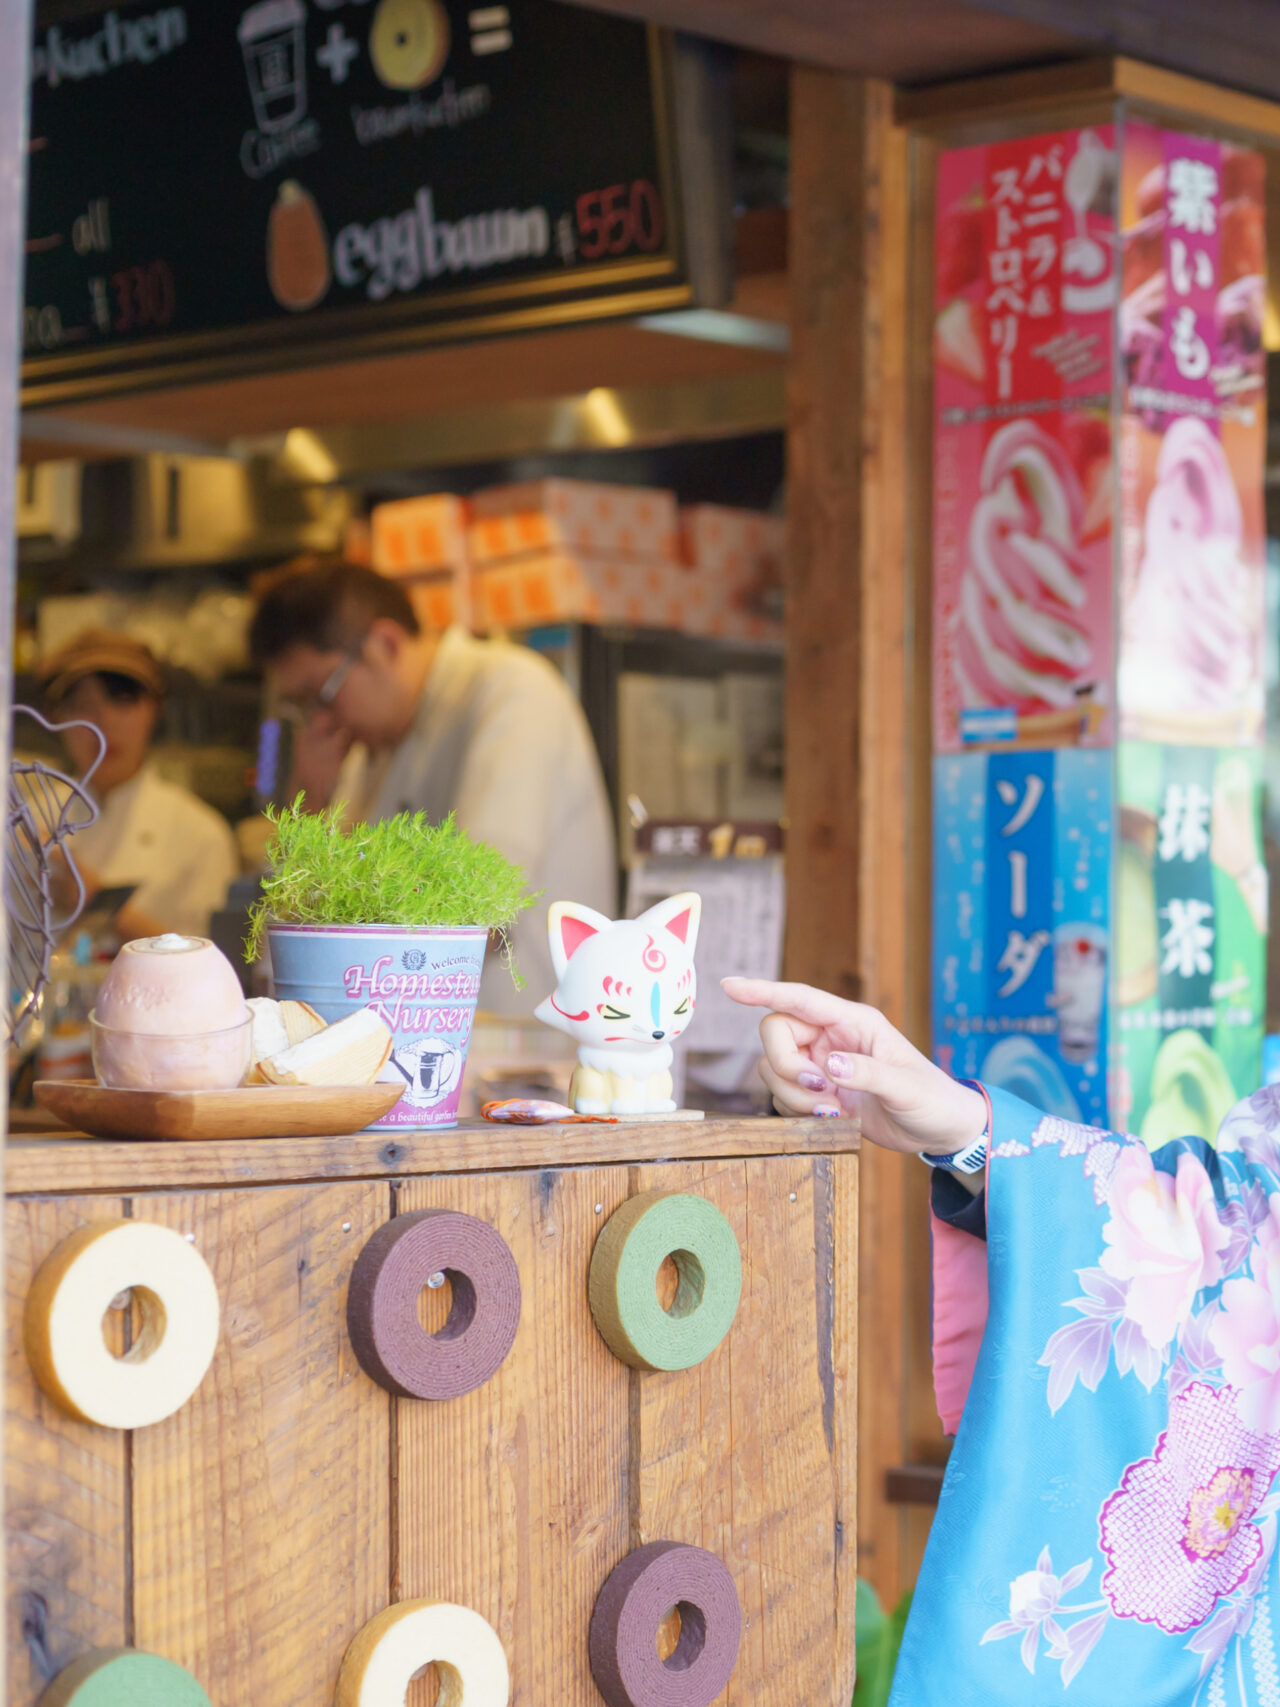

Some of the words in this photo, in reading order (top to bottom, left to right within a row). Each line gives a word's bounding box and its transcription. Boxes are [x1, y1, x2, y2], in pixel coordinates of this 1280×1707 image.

[986, 167, 1026, 400] ストロベリー
[1166, 156, 1219, 380] 紫いも
[997, 774, 1051, 998] ソーダ
[1158, 783, 1217, 979] 抹茶
[364, 996, 473, 1048] Nursery
[398, 1111, 434, 1123] beautiful
